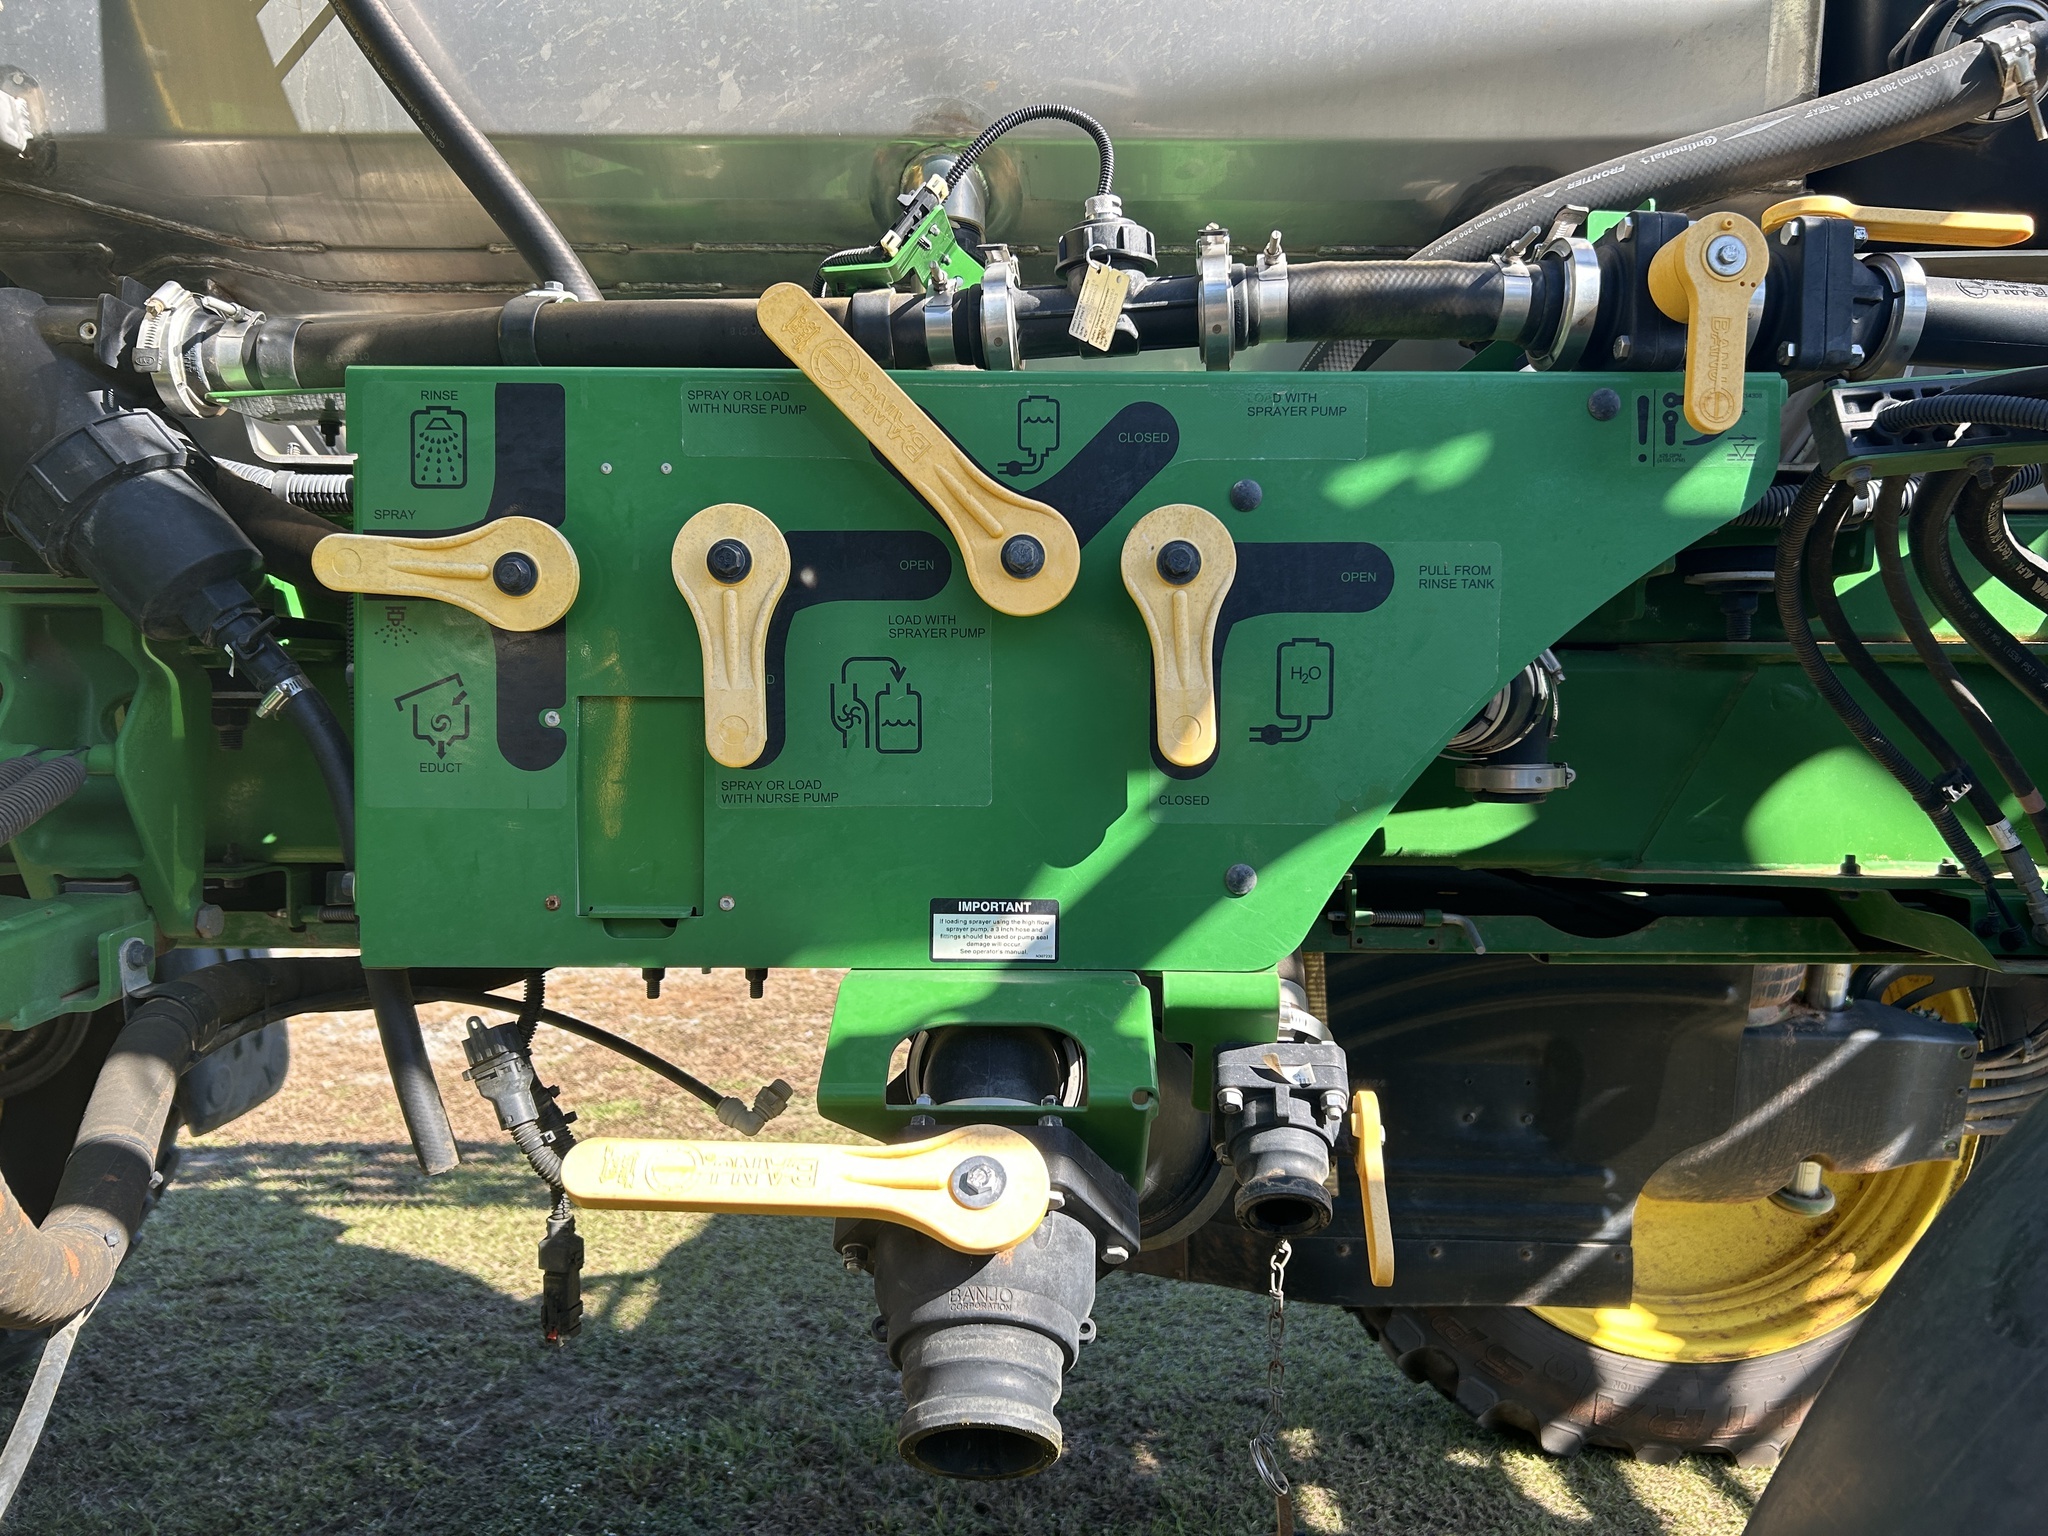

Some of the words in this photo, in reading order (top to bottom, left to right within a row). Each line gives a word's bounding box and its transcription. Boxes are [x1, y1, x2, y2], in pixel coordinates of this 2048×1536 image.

[1881, 81, 1897, 94] 200
[1863, 88, 1880, 101] PSI
[1649, 135, 1718, 164] Continental
[1458, 225, 1474, 238] 200
[1442, 234, 1458, 247] PSI
[420, 390, 458, 400] RINSE
[687, 390, 729, 400] SPRAY
[733, 390, 752, 401] OR
[755, 391, 790, 401] LOAD
[1285, 392, 1317, 403] WITH
[688, 403, 720, 414] WITH
[723, 404, 767, 414] NURSE
[770, 404, 807, 415] PUMP
[1247, 406, 1308, 417] SPRAYER
[1311, 406, 1347, 417] PUMP
[1118, 432, 1170, 443] CLOSED
[374, 509, 416, 520] SPRAY
[900, 560, 935, 571] OPEN
[1419, 565, 1450, 576] PULL
[1455, 565, 1491, 576] FROM
[1340, 571, 1377, 583] OPEN
[1419, 578, 1457, 589] RINSE
[1461, 578, 1494, 589] TANK
[888, 615, 921, 625] LOAD
[925, 615, 956, 625] WITH
[889, 628, 948, 638] SPRAYER
[951, 628, 986, 638] PUMP
[419, 763, 462, 773] EDUCT
[721, 781, 763, 790] SPRAY
[766, 780, 785, 790] OR
[788, 780, 822, 790] LOAD
[721, 794, 753, 804] WITH
[757, 793, 799, 803] NURSE
[803, 792, 839, 803] PUMP
[1158, 795, 1210, 806] CLOSED
[958, 901, 1032, 913] IMPORTANT
[948, 1286, 1013, 1304] BANJO
[950, 1302, 1012, 1312] CORPORATION
